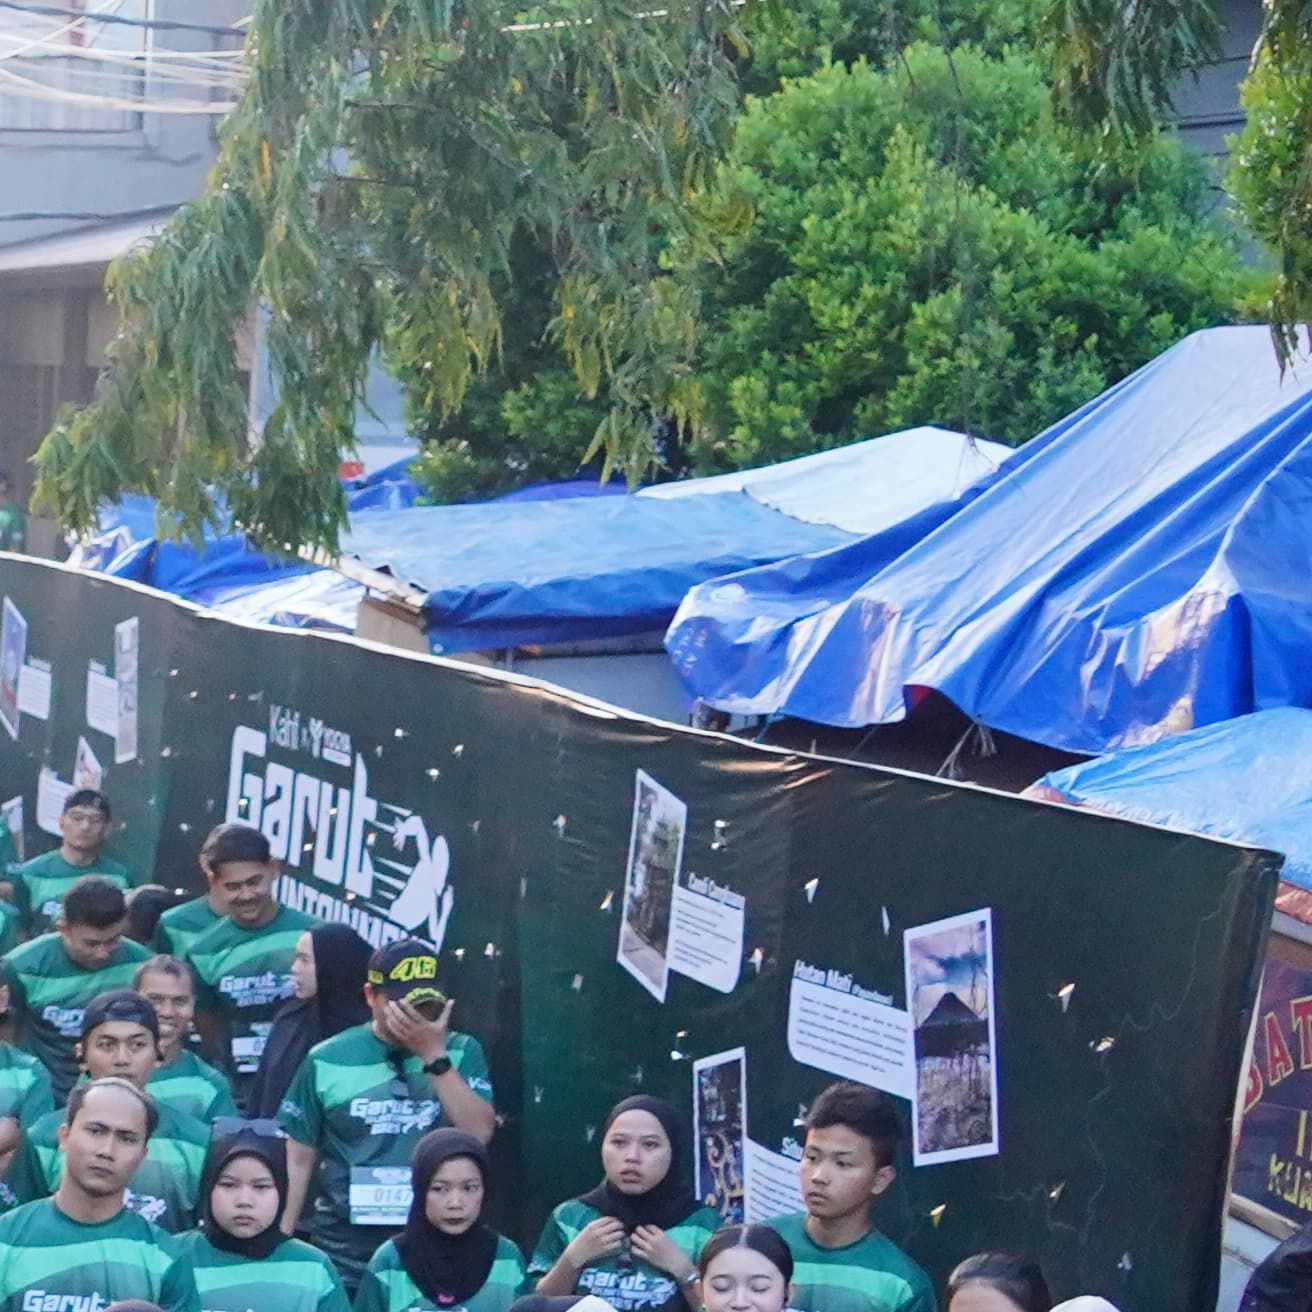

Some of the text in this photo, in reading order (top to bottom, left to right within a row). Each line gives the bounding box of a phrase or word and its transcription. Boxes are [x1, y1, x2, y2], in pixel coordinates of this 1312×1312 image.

[226, 725, 378, 898] Garut
[389, 955, 438, 982] 46
[220, 971, 276, 991] Garut
[350, 1097, 414, 1118] Garut
[578, 1267, 648, 1291] Garut
